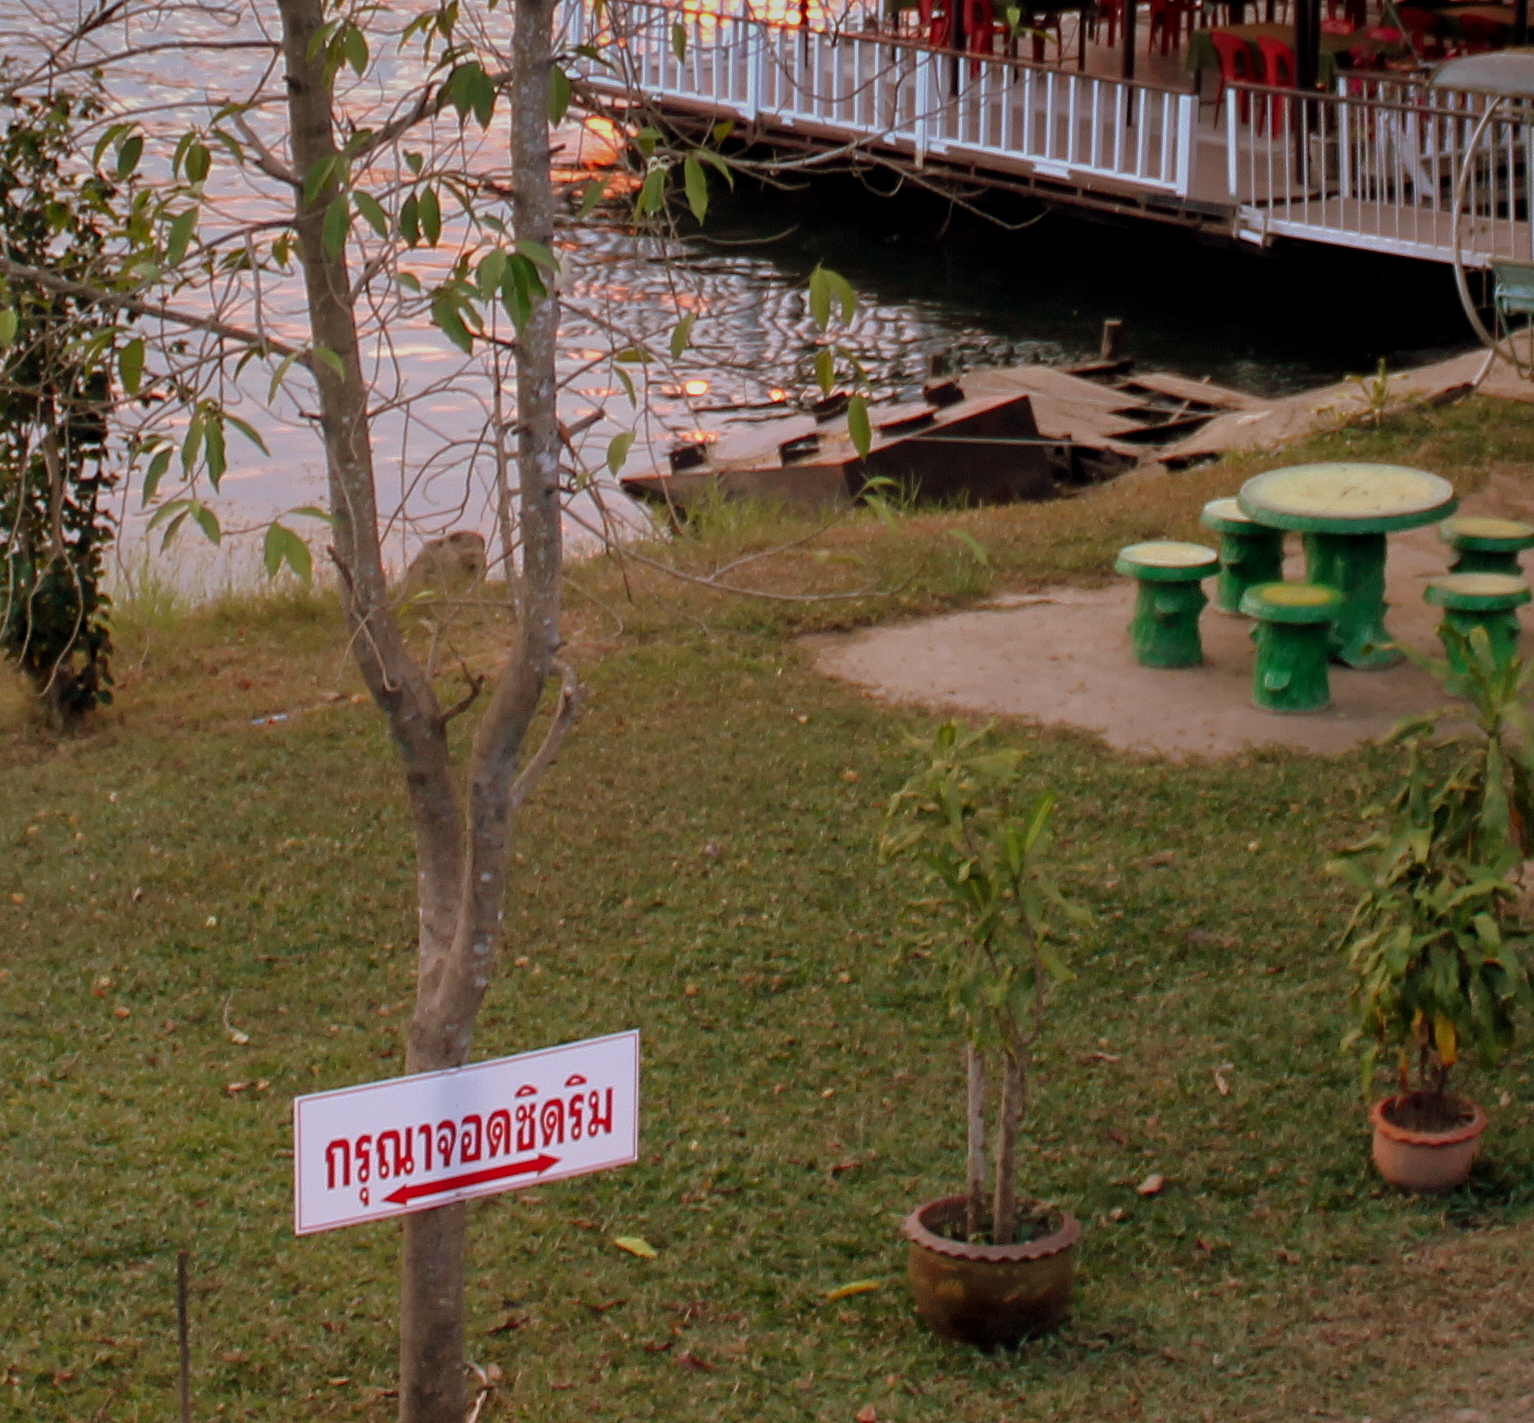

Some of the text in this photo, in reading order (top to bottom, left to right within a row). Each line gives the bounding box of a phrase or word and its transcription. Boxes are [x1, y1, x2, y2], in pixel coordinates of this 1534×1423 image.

[324, 1073, 615, 1206] กรุณาจอดชิดริม
